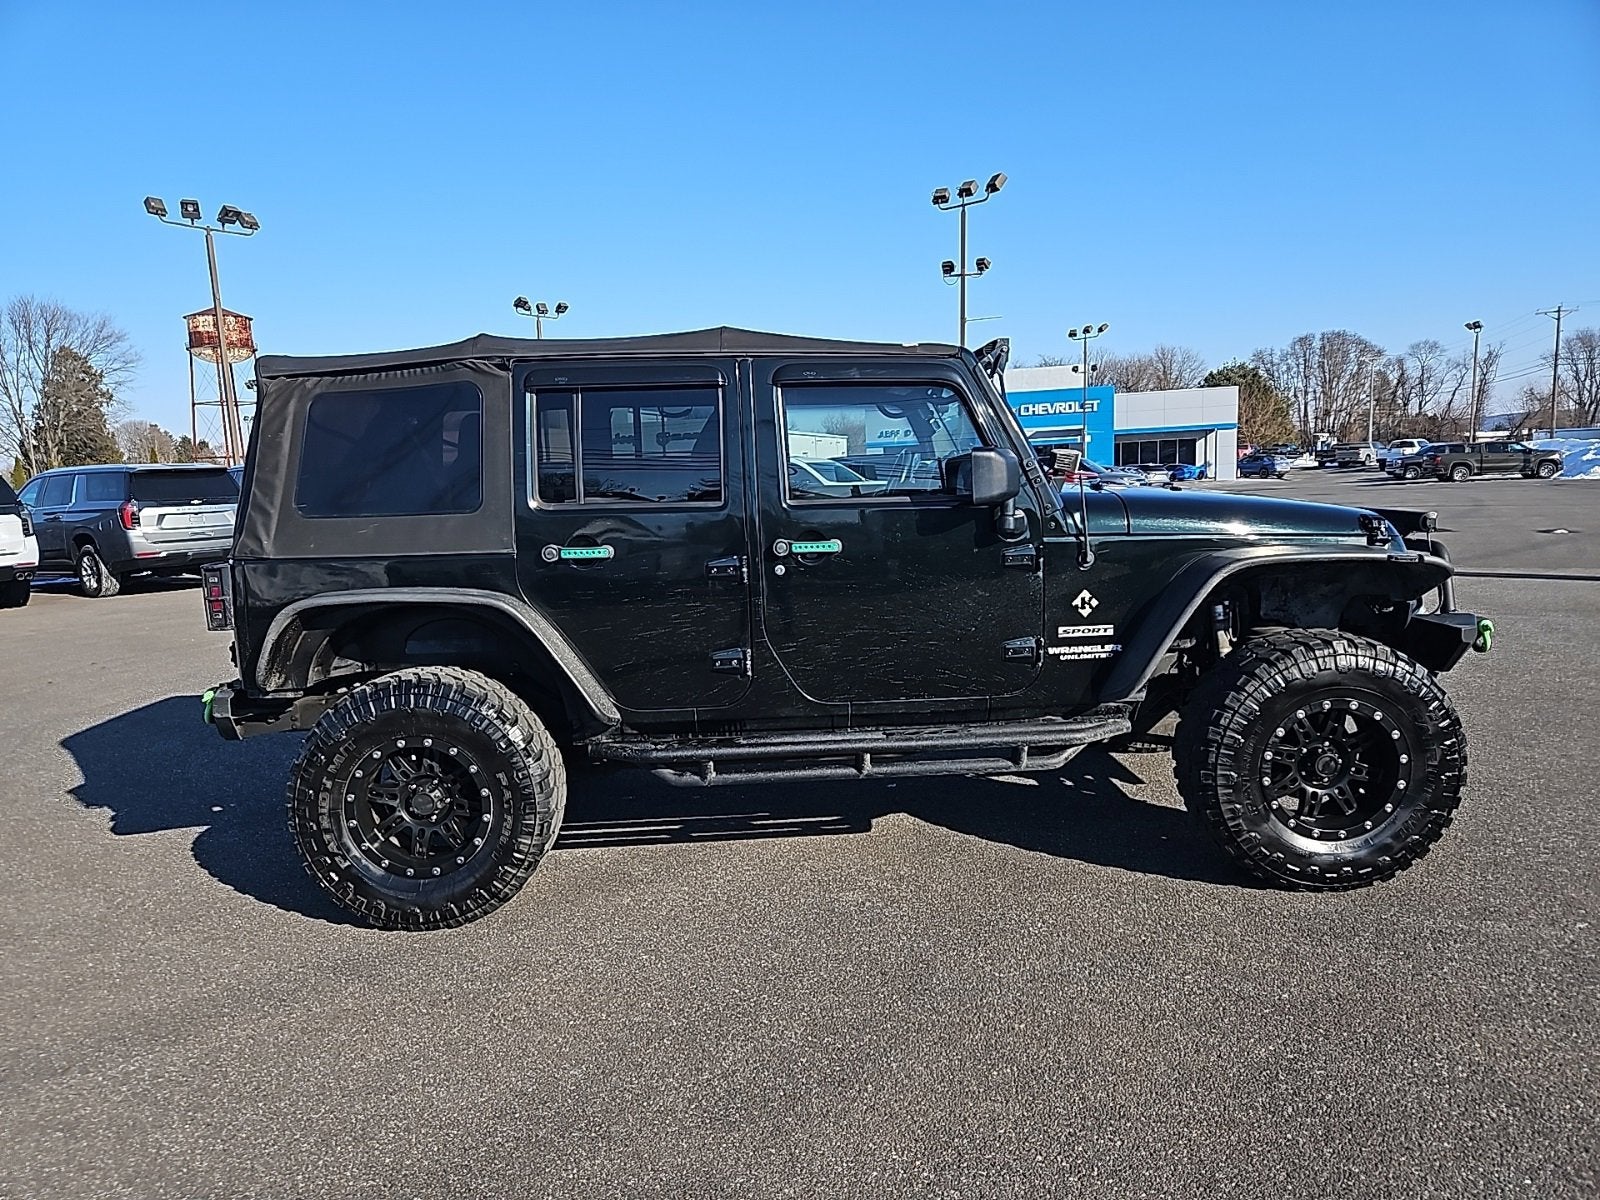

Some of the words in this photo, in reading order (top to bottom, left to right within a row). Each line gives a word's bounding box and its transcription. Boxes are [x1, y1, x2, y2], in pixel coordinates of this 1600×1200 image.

[1020, 400, 1100, 416] CHEVROLET
[877, 429, 900, 438] JEFF
[1060, 627, 1113, 635] SPORT
[1047, 644, 1122, 654] WRANGLER
[318, 776, 352, 870] PATRIOT
